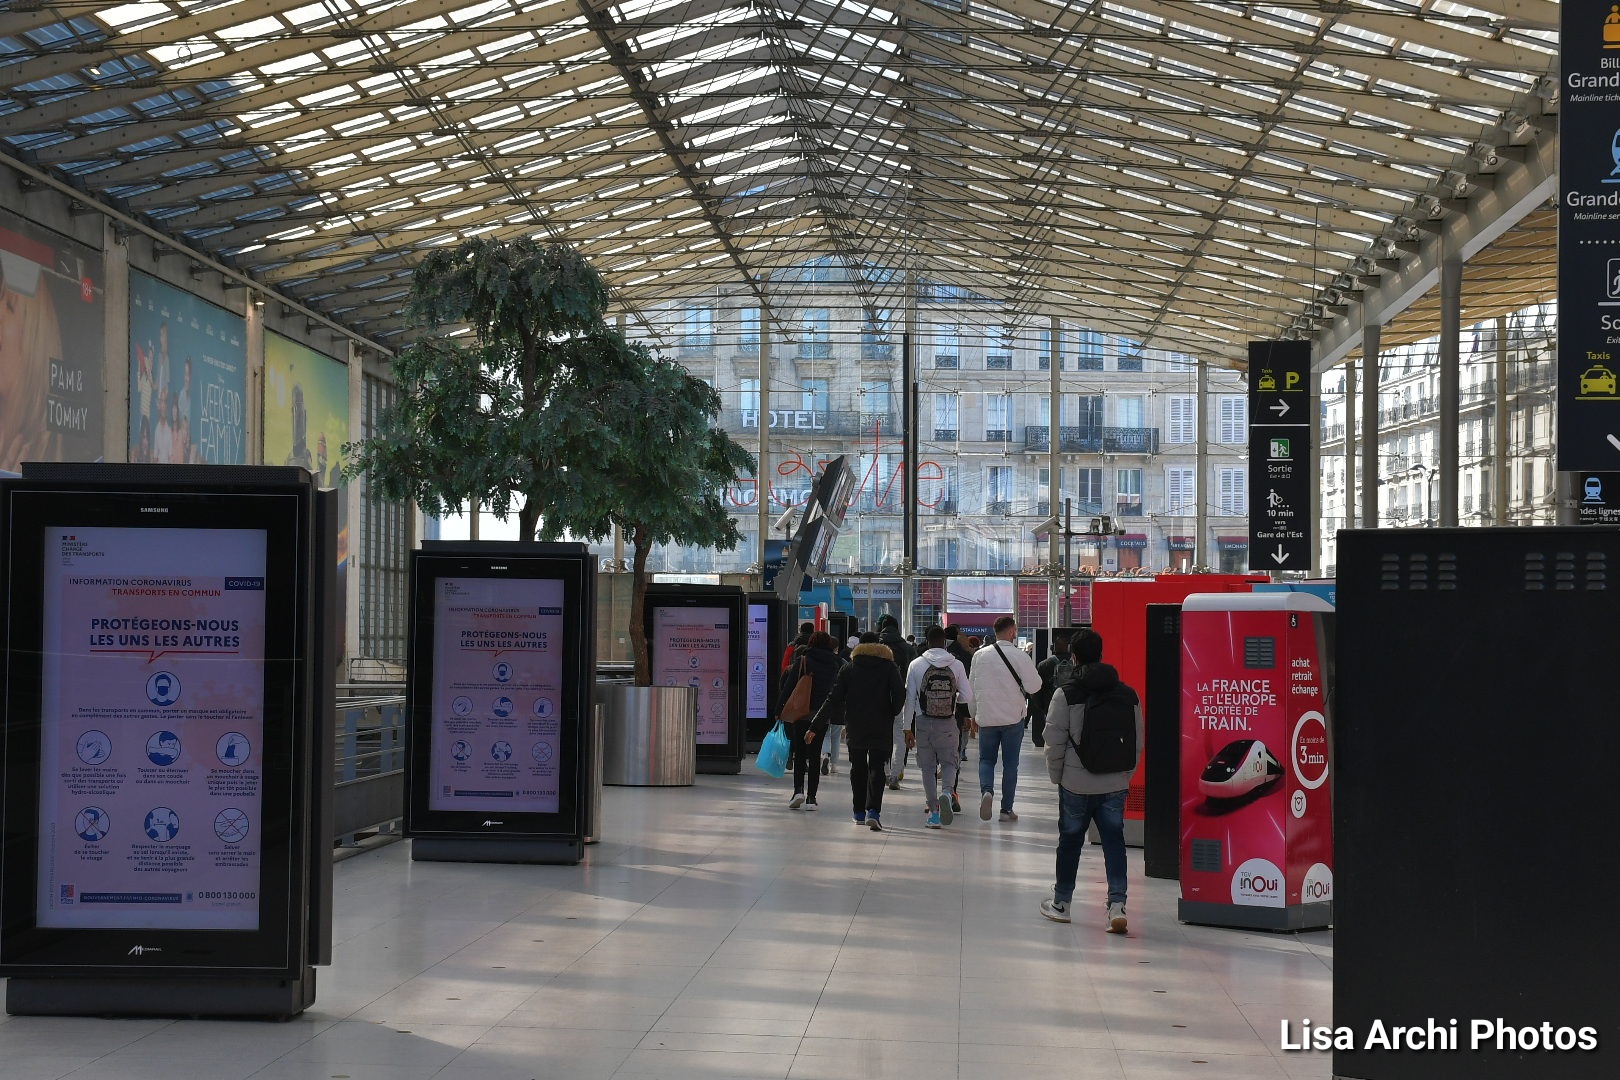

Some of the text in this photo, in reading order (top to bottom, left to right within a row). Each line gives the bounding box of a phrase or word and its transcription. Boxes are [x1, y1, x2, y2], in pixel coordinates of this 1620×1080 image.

[1570, 94, 1603, 102] Mainline
[1567, 191, 1620, 206] Grand
[1574, 212, 1607, 220] Mainline
[82, 283, 92, 297] 18+
[1586, 352, 1610, 360] Taxis
[51, 363, 83, 392] PAM &
[1285, 371, 1300, 389] P
[48, 400, 88, 431] TOMMY
[742, 410, 824, 430] HOTEL
[201, 418, 241, 465] FAMILY
[1267, 464, 1292, 472] Sortie
[1266, 509, 1294, 517] 10 min
[70, 578, 192, 587] INFORMATION CORONAVIRUS
[112, 588, 167, 596] TRANSPORTS
[182, 589, 221, 597] COMMUN
[91, 616, 239, 632] PROTÉGEONS-NOUS
[90, 634, 240, 648] LES UNS LES AUTRES
[461, 629, 547, 640] PROTÉGEONS-NOUS
[476, 640, 496, 648] UNS
[514, 641, 548, 649] AUTRES
[1291, 657, 1310, 668] achat
[1291, 671, 1313, 681] retrait
[1197, 679, 1270, 693] LA FRANCE
[1291, 684, 1319, 697] échange
[1202, 693, 1277, 706] ET L'EUROPE
[1194, 704, 1258, 716] À PORTÉE DE
[1198, 715, 1252, 731] TRAIN.
[1299, 745, 1325, 764] 3 min
